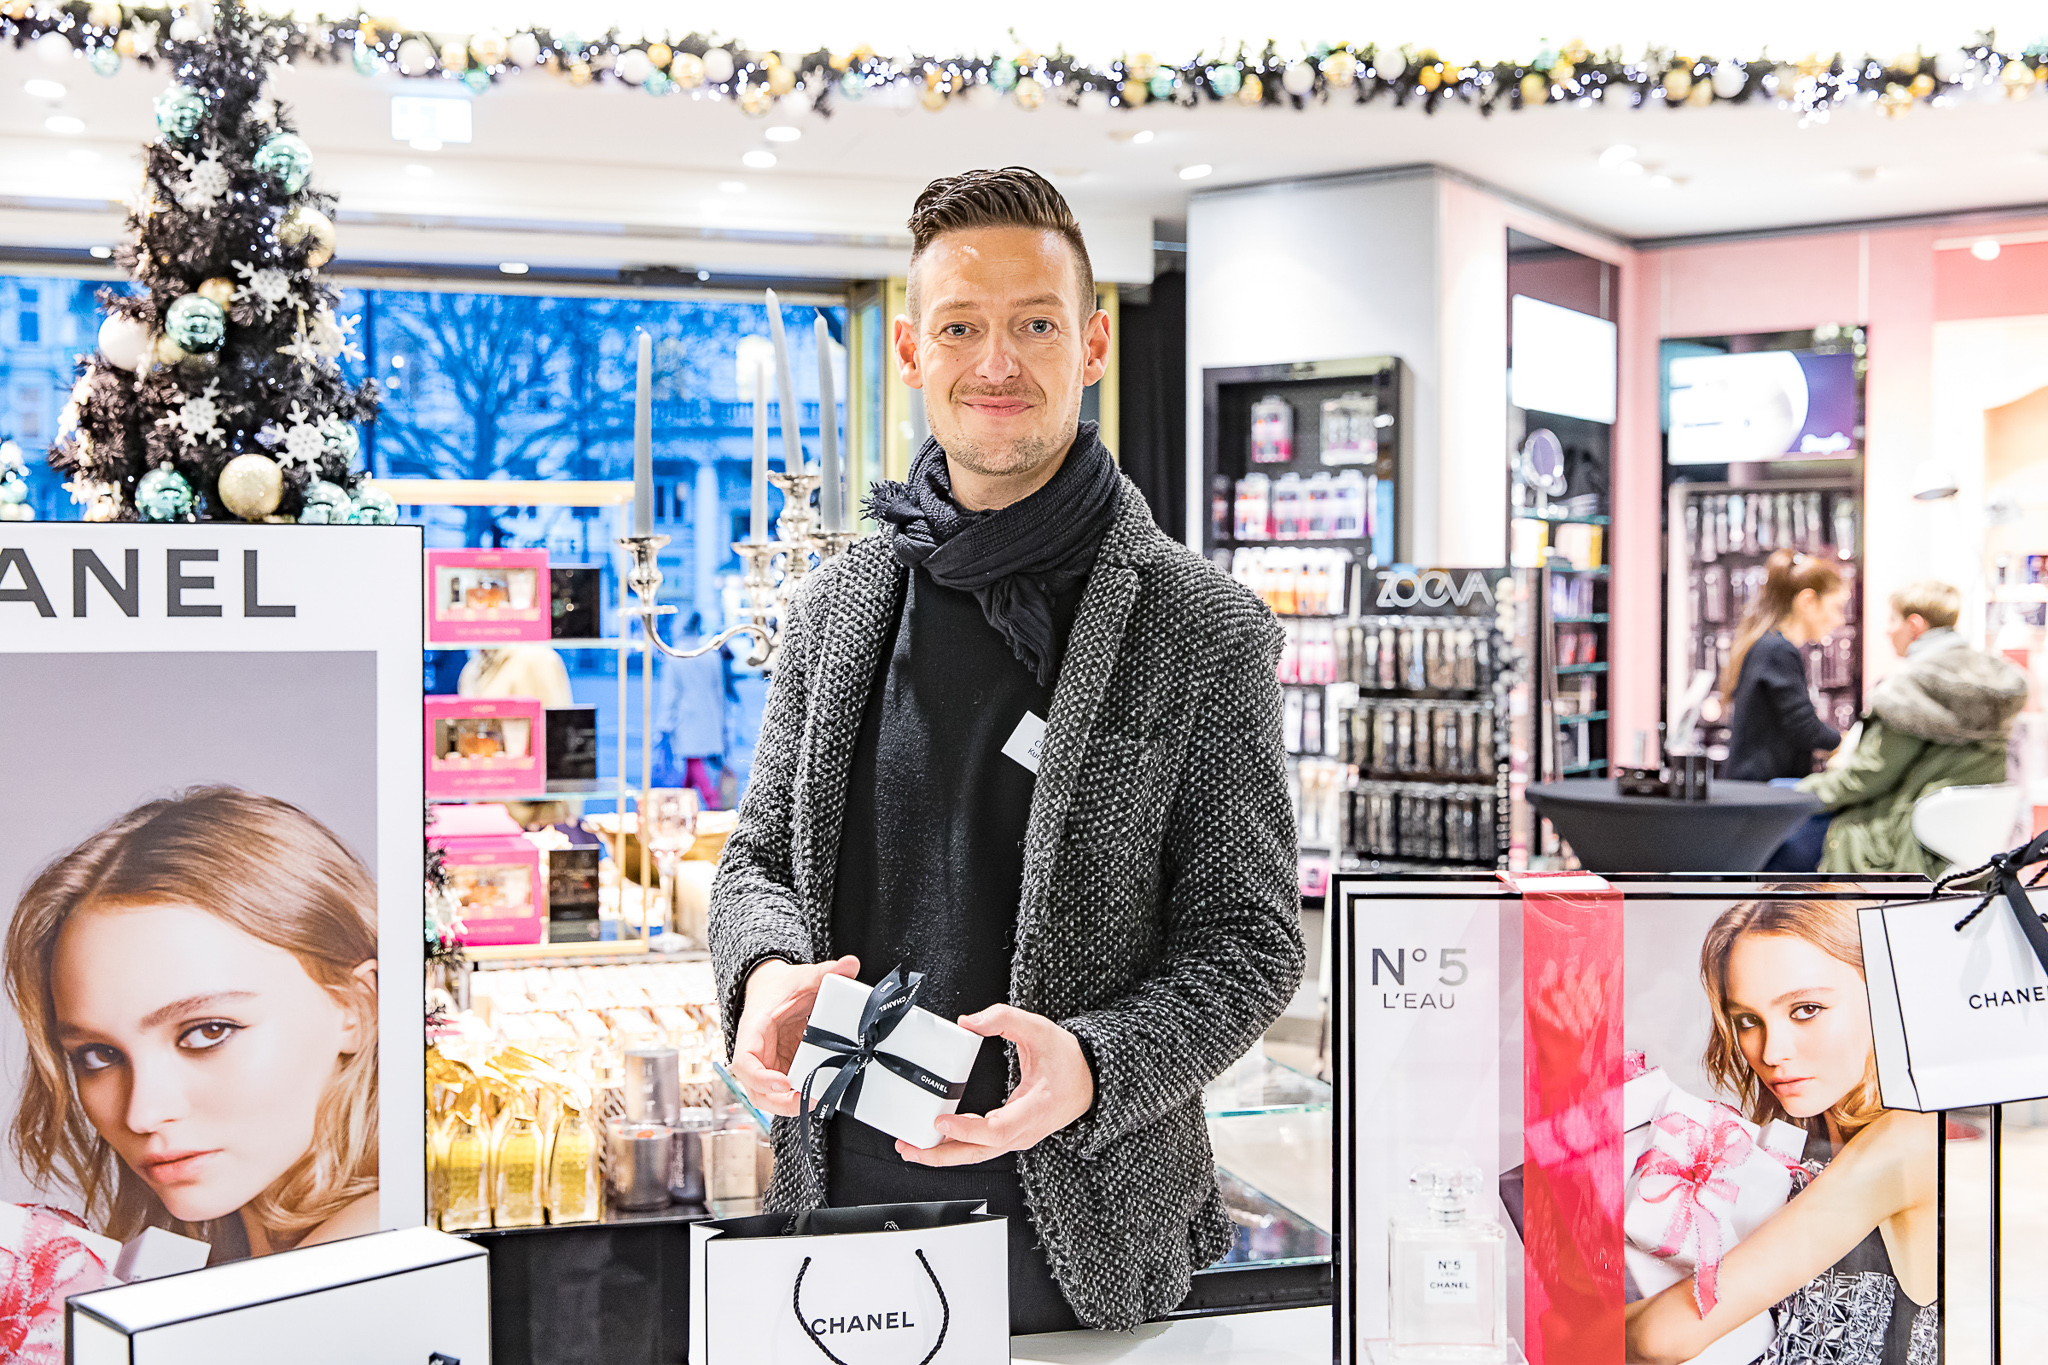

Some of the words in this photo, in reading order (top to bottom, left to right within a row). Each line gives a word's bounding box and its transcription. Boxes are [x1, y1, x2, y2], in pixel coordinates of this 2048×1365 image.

[1438, 948, 1468, 986] 5
[878, 995, 907, 1012] CHANEL
[1383, 993, 1455, 1009] L'EAU
[1969, 985, 2048, 1009] CHANE
[920, 1074, 948, 1093] CHANEL
[1454, 1260, 1461, 1270] 5
[1429, 1281, 1471, 1289] CHANEL
[811, 1311, 915, 1336] CHANEL
